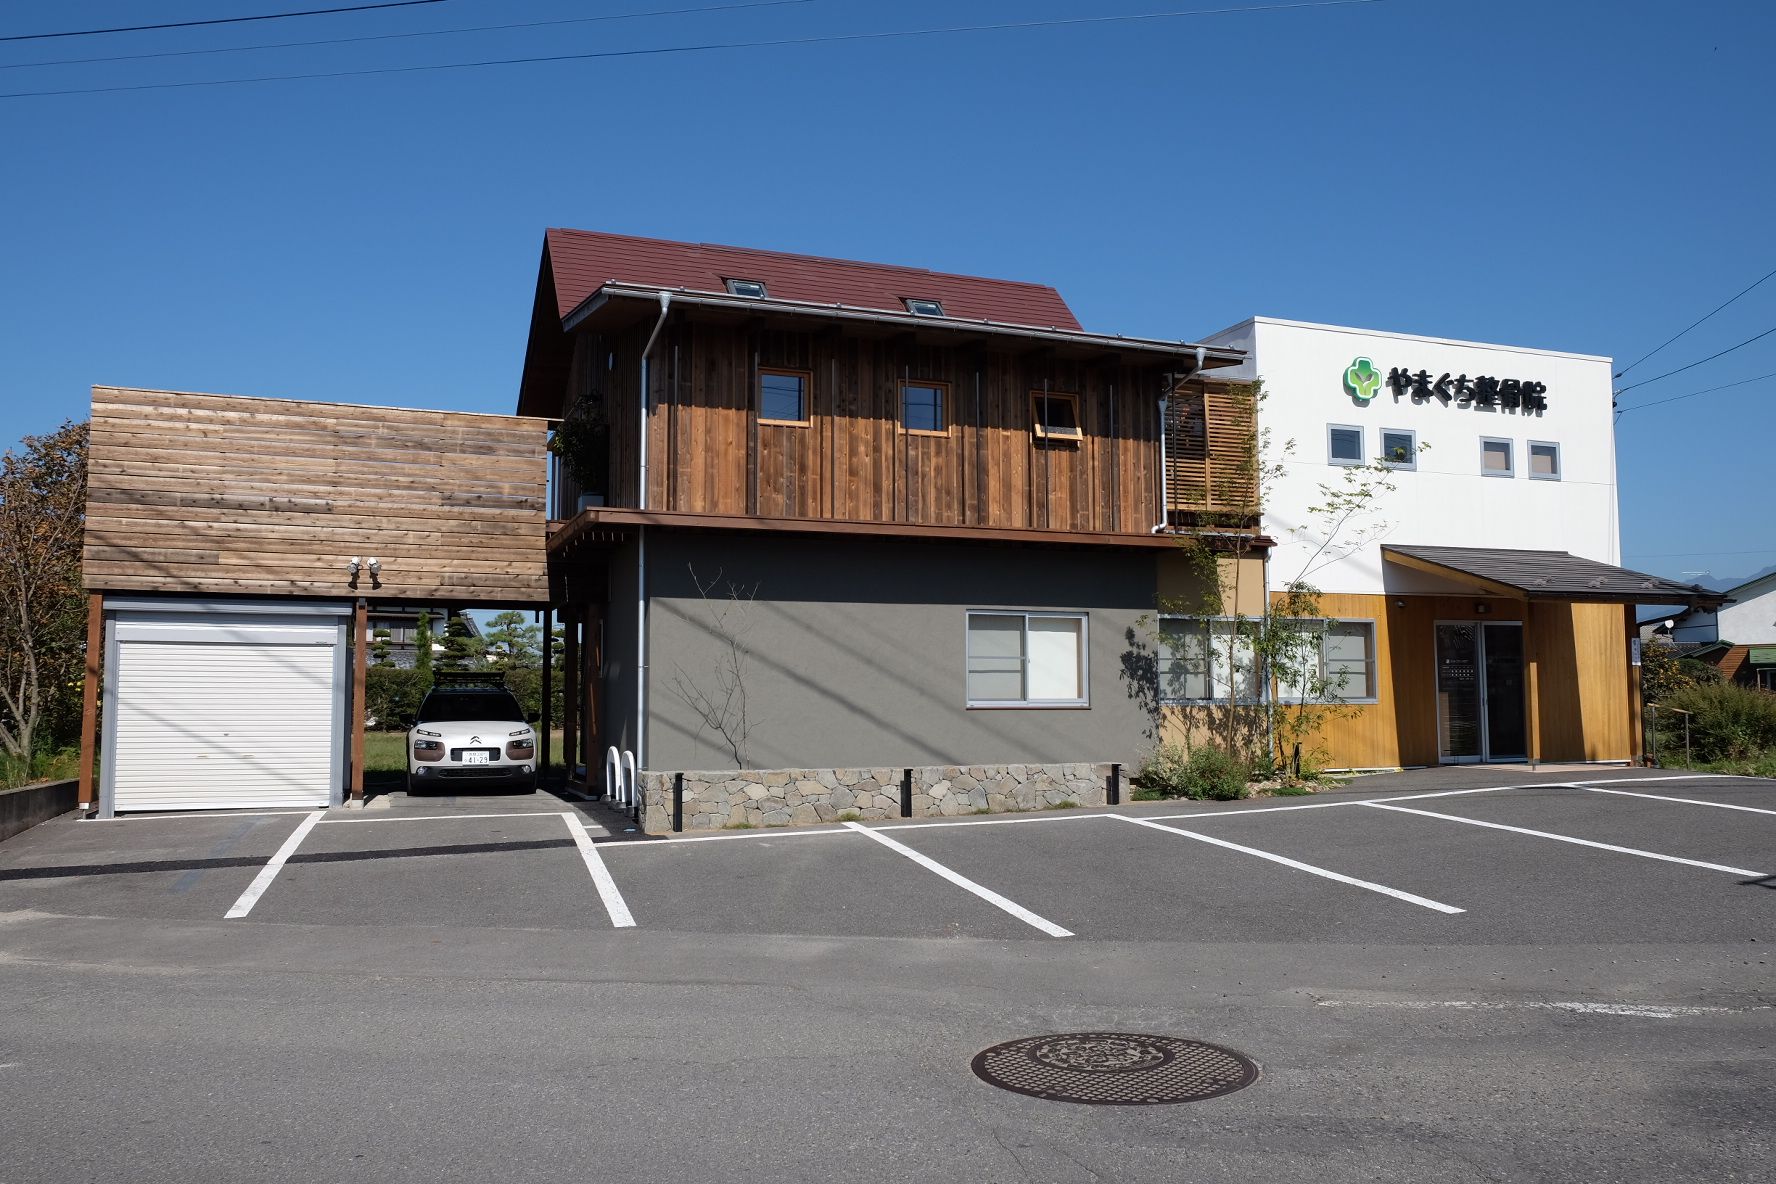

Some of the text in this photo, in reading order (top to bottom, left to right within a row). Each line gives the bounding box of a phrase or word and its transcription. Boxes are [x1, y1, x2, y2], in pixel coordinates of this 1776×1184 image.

[1386, 366, 1548, 413] やまぐち整骨院
